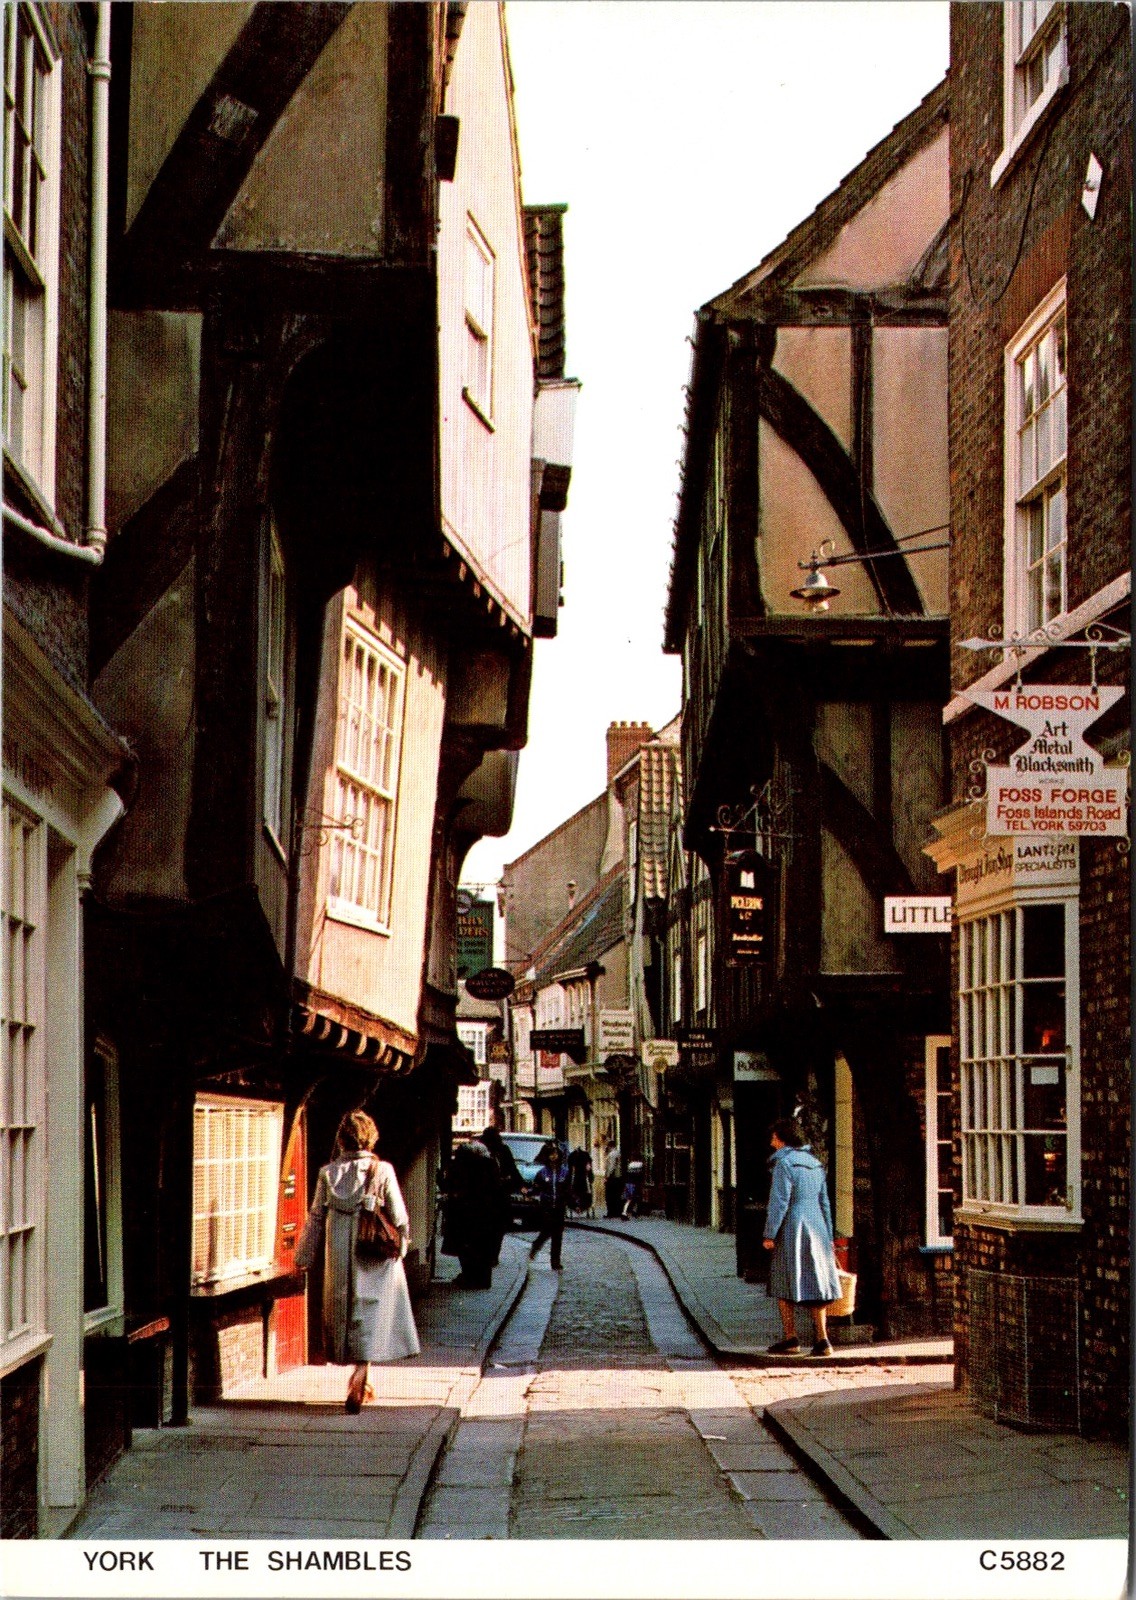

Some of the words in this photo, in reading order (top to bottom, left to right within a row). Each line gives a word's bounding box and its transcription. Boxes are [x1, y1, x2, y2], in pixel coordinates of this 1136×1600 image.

[994, 696, 1010, 710] M
[1016, 695, 1099, 710] ROBSON
[1039, 720, 1069, 738] Art
[1030, 739, 1073, 755] Metal
[1014, 755, 1094, 776] Blacksmith
[999, 788, 1042, 802] FOSS
[1050, 789, 1117, 803] FORGE
[997, 805, 1031, 819] Foss
[1034, 806, 1083, 820] Islands
[1086, 806, 1121, 820] Road
[1031, 820, 1064, 831] YORK
[1068, 821, 1107, 832] 59703
[1015, 858, 1077, 872] SPECIALISTS
[892, 906, 952, 923] LITTLE
